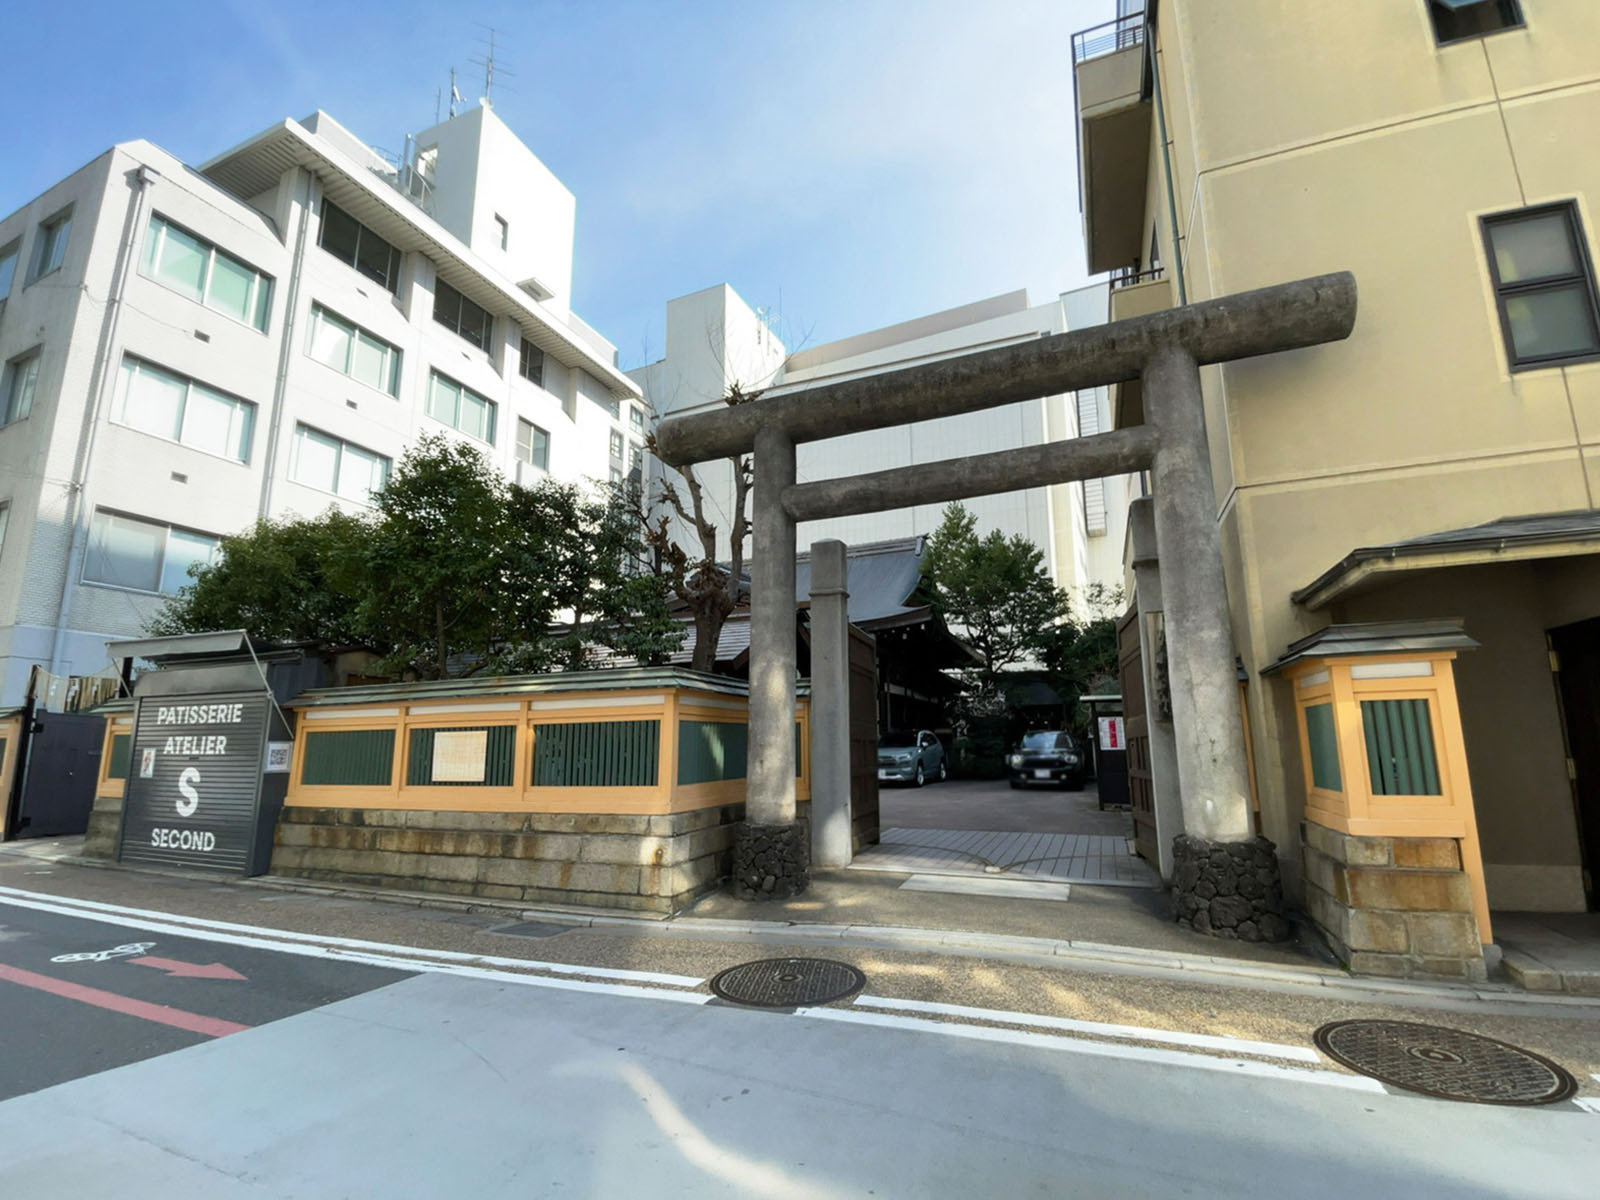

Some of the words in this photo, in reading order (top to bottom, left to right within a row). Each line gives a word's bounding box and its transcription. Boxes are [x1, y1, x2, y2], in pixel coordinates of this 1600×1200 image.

[157, 703, 243, 725] PATISSERIE
[163, 736, 227, 755] ATELIER
[175, 767, 201, 817] S
[151, 828, 215, 851] SECOND
